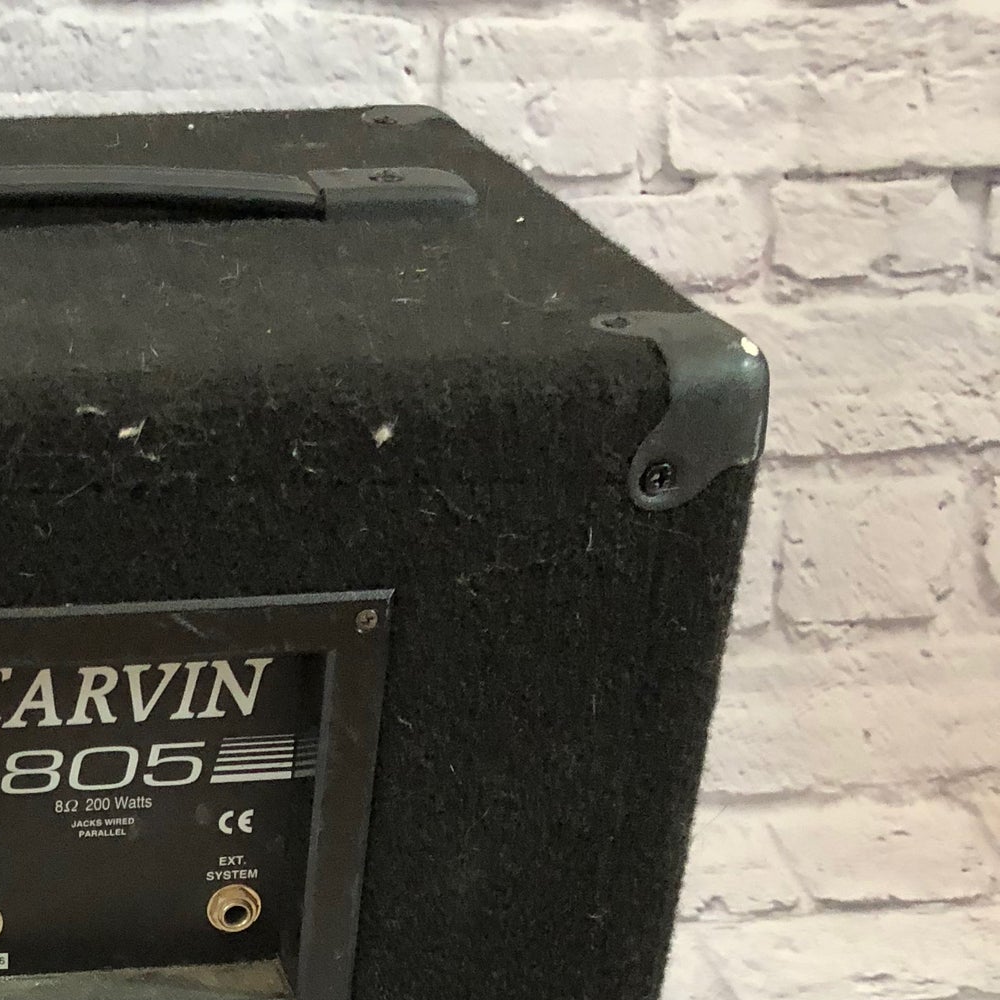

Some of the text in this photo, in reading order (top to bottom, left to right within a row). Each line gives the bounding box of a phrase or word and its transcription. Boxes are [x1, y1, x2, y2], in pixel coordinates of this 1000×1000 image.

[1, 741, 205, 794] 805
[85, 797, 111, 811] 200
[114, 795, 153, 809] Watts
[71, 817, 135, 828] JACKS WIRED
[218, 808, 255, 835] CE
[78, 828, 127, 838] PARALLEL
[219, 855, 247, 866] EXT.
[206, 868, 259, 881] SYSTEM
